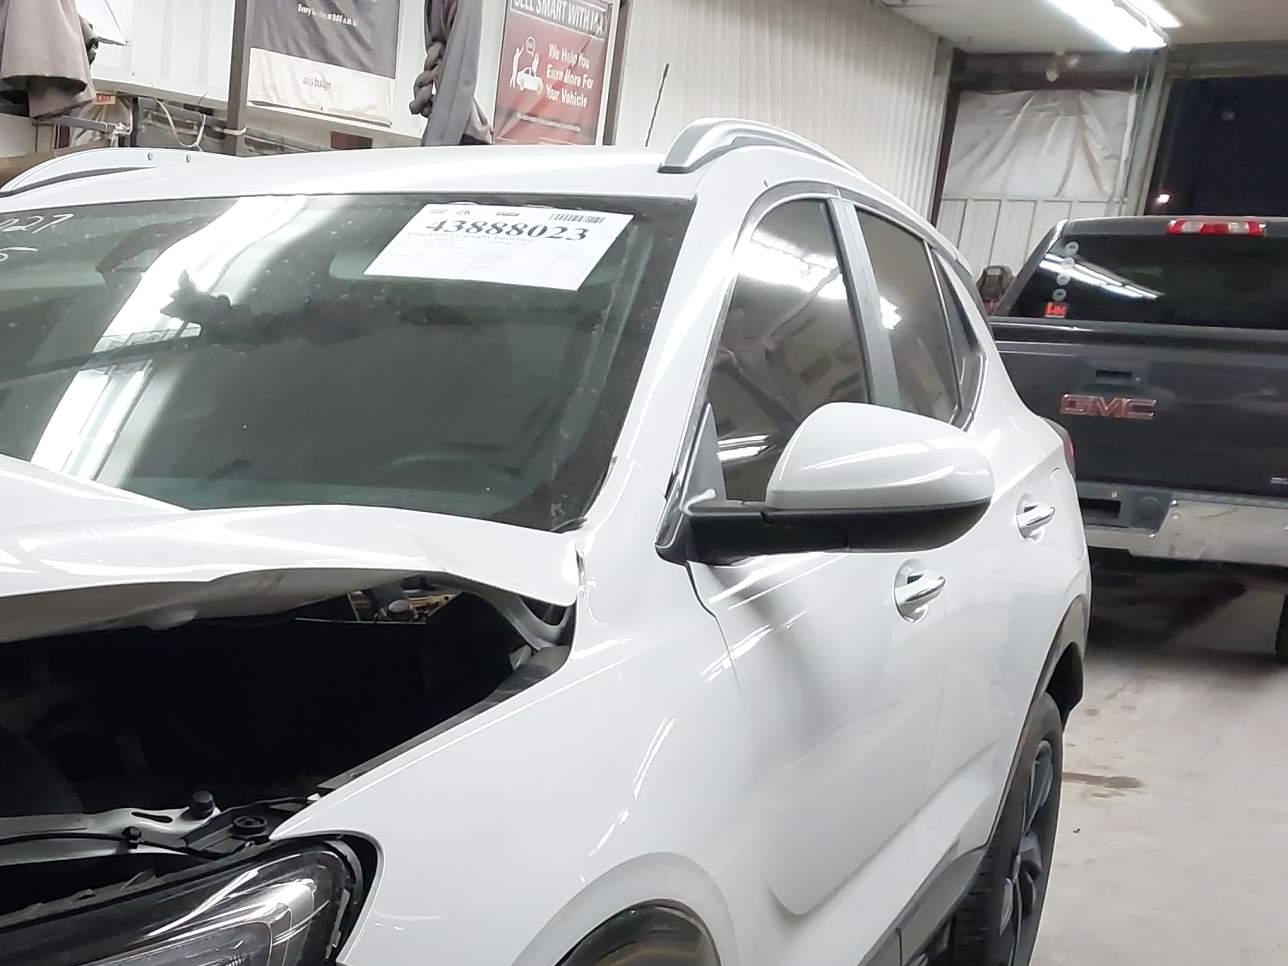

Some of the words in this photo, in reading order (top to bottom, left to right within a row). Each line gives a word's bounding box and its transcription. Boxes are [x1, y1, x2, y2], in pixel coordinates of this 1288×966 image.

[536, 0, 567, 22] SMART
[568, 4, 590, 30] WITH
[548, 43, 560, 60] We
[561, 48, 578, 66] Help
[578, 52, 590, 70] You
[546, 64, 564, 81] Earn
[563, 67, 582, 87] More
[545, 83, 560, 101] Your
[560, 86, 588, 108] Vehicle
[426, 218, 589, 241] 43888023
[1061, 394, 1157, 419] GMC
